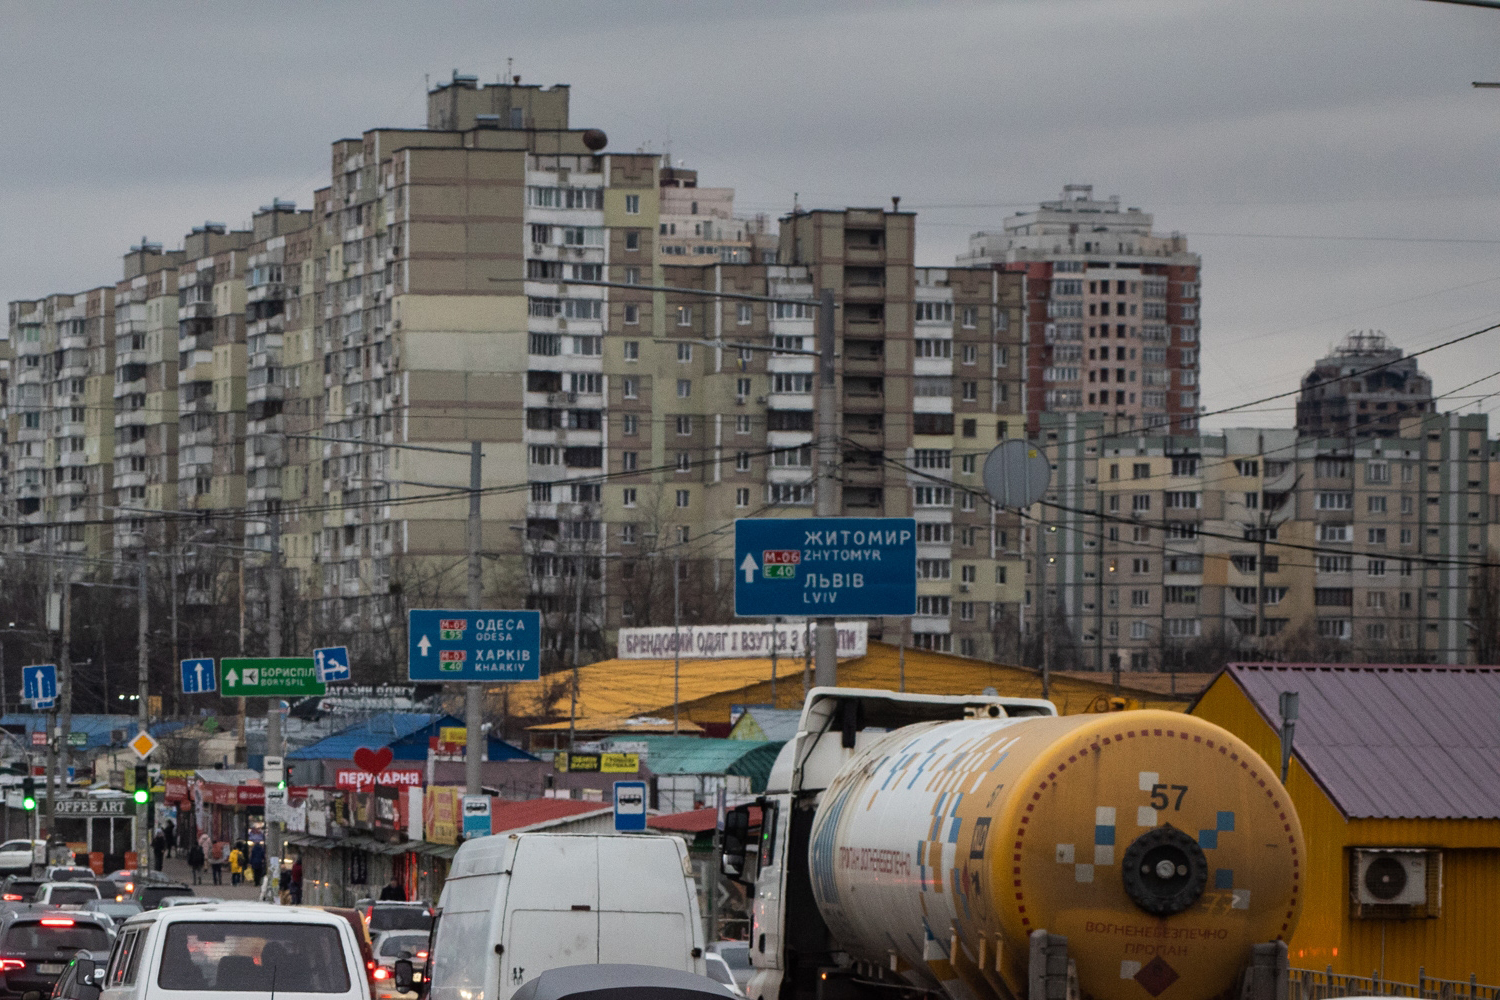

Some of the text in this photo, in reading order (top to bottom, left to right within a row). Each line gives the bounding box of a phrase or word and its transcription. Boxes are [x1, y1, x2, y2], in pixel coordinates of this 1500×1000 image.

[803, 530, 912, 546] ЖИТОМИР
[803, 549, 882, 562] ZHYTOMYR
[776, 566, 794, 577] 40
[803, 573, 865, 588] ЛЬВІВ
[803, 592, 838, 604] LVIV
[475, 619, 526, 631] ОДЕСА
[475, 633, 513, 641] ODESA
[696, 631, 729, 655] ОДЯГ
[475, 650, 531, 661] ХАРКІВ
[260, 667, 316, 678] БОРИСПІЛ
[474, 663, 526, 672] KHARKIV
[260, 678, 305, 687] BORYSPIL
[338, 771, 420, 785] ПЕРУКАРНЯ
[1150, 783, 1189, 811] 57
[54, 801, 126, 812] OFFEE ART
[1085, 921, 1228, 940] ВОГНЕНЕБЕЗПЕЧНО
[1124, 943, 1189, 956] ПРОПАН
